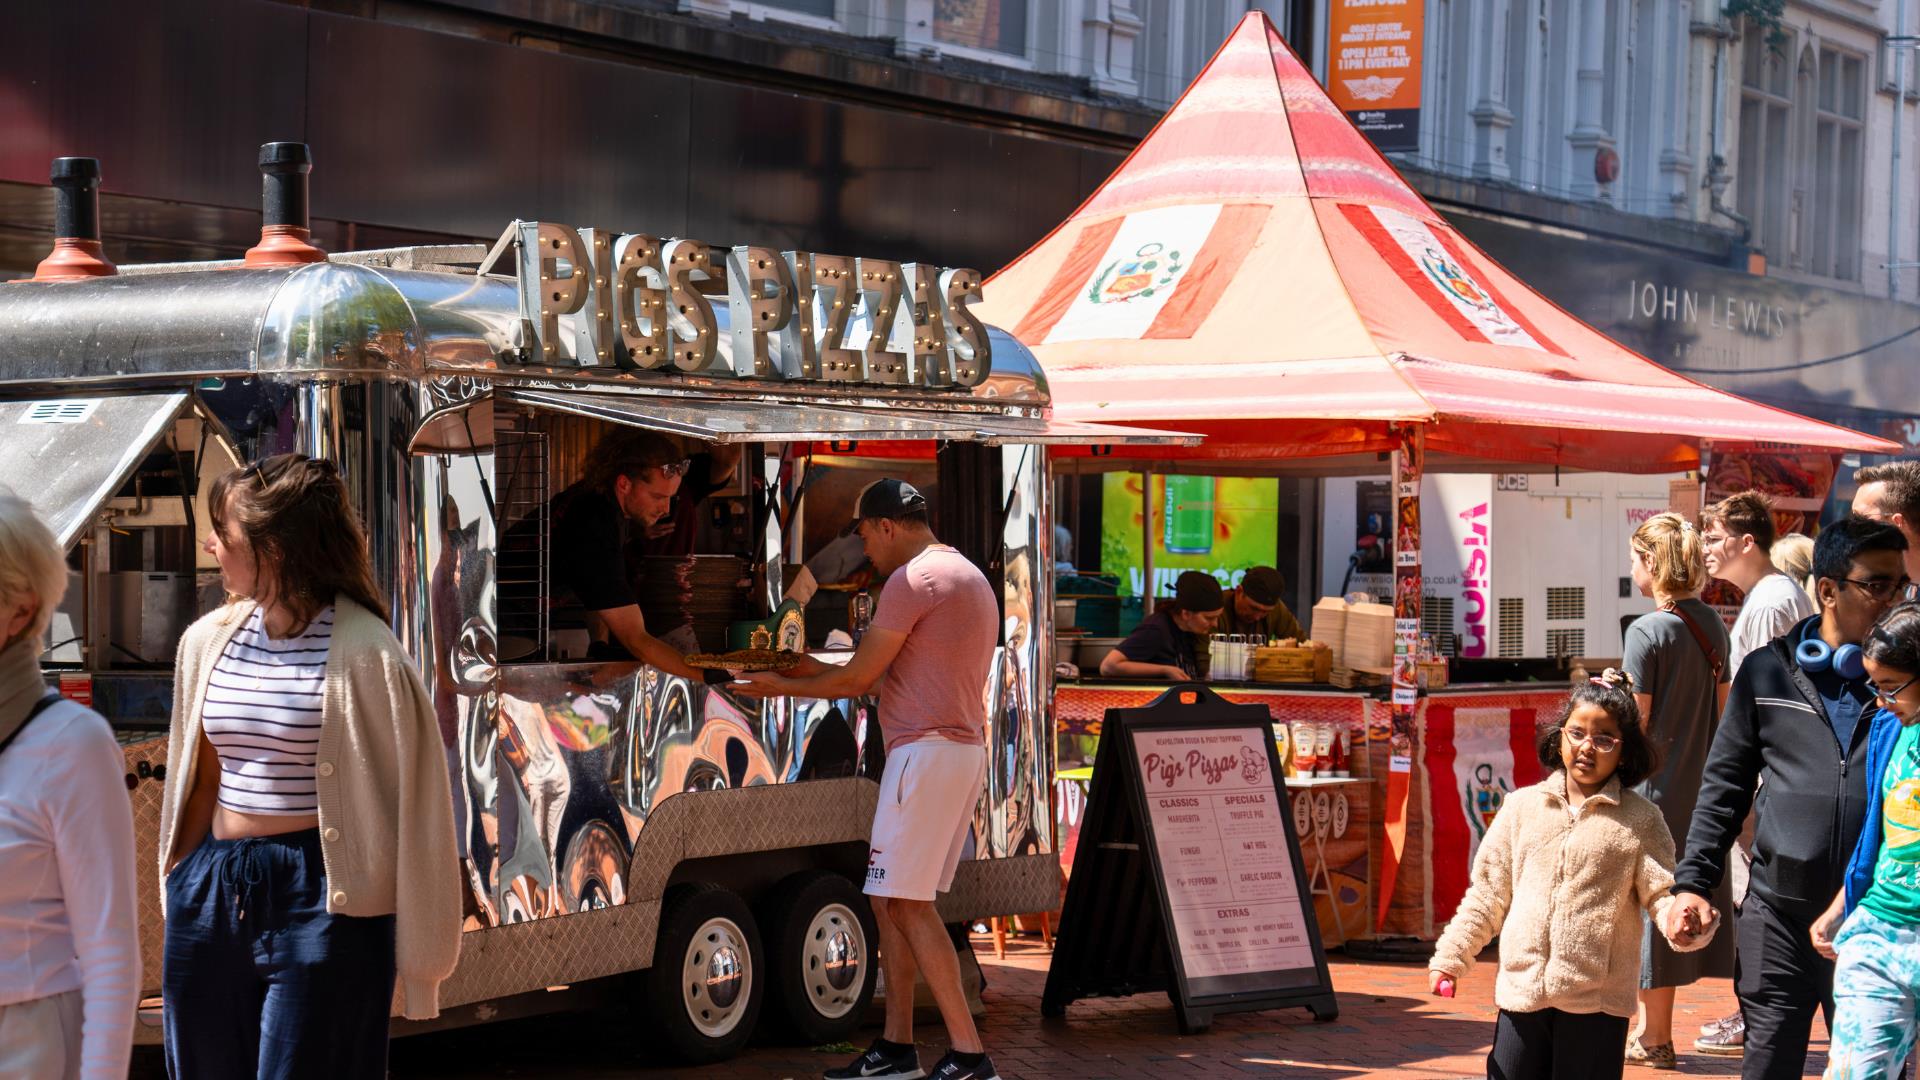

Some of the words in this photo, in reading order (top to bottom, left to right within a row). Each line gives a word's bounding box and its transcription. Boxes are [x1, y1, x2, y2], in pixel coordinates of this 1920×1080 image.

[1341, 47, 1366, 58] OPEN
[1367, 46, 1388, 57] LATE
[1338, 58, 1363, 70] 11PM
[1365, 56, 1411, 69] EVERYDAY
[519, 220, 718, 372] PIGS
[731, 245, 992, 388] PIZZAS
[1628, 279, 1699, 324] JOHN
[1710, 295, 1785, 338] LEWIS
[1498, 473, 1528, 490] JCB
[1165, 487, 1174, 511] Bull
[1185, 749, 1238, 785] Pizzas
[1159, 798, 1200, 809] CLASSICS
[1224, 794, 1265, 805] SPECIALS
[1167, 814, 1200, 824] MARGHERITA
[1230, 811, 1252, 820] TRUFFLE
[1254, 809, 1264, 819] PIG
[1188, 876, 1218, 886] PEPPERONI
[1240, 873, 1261, 882] GARLIC
[1217, 907, 1250, 919] EXTRAS
